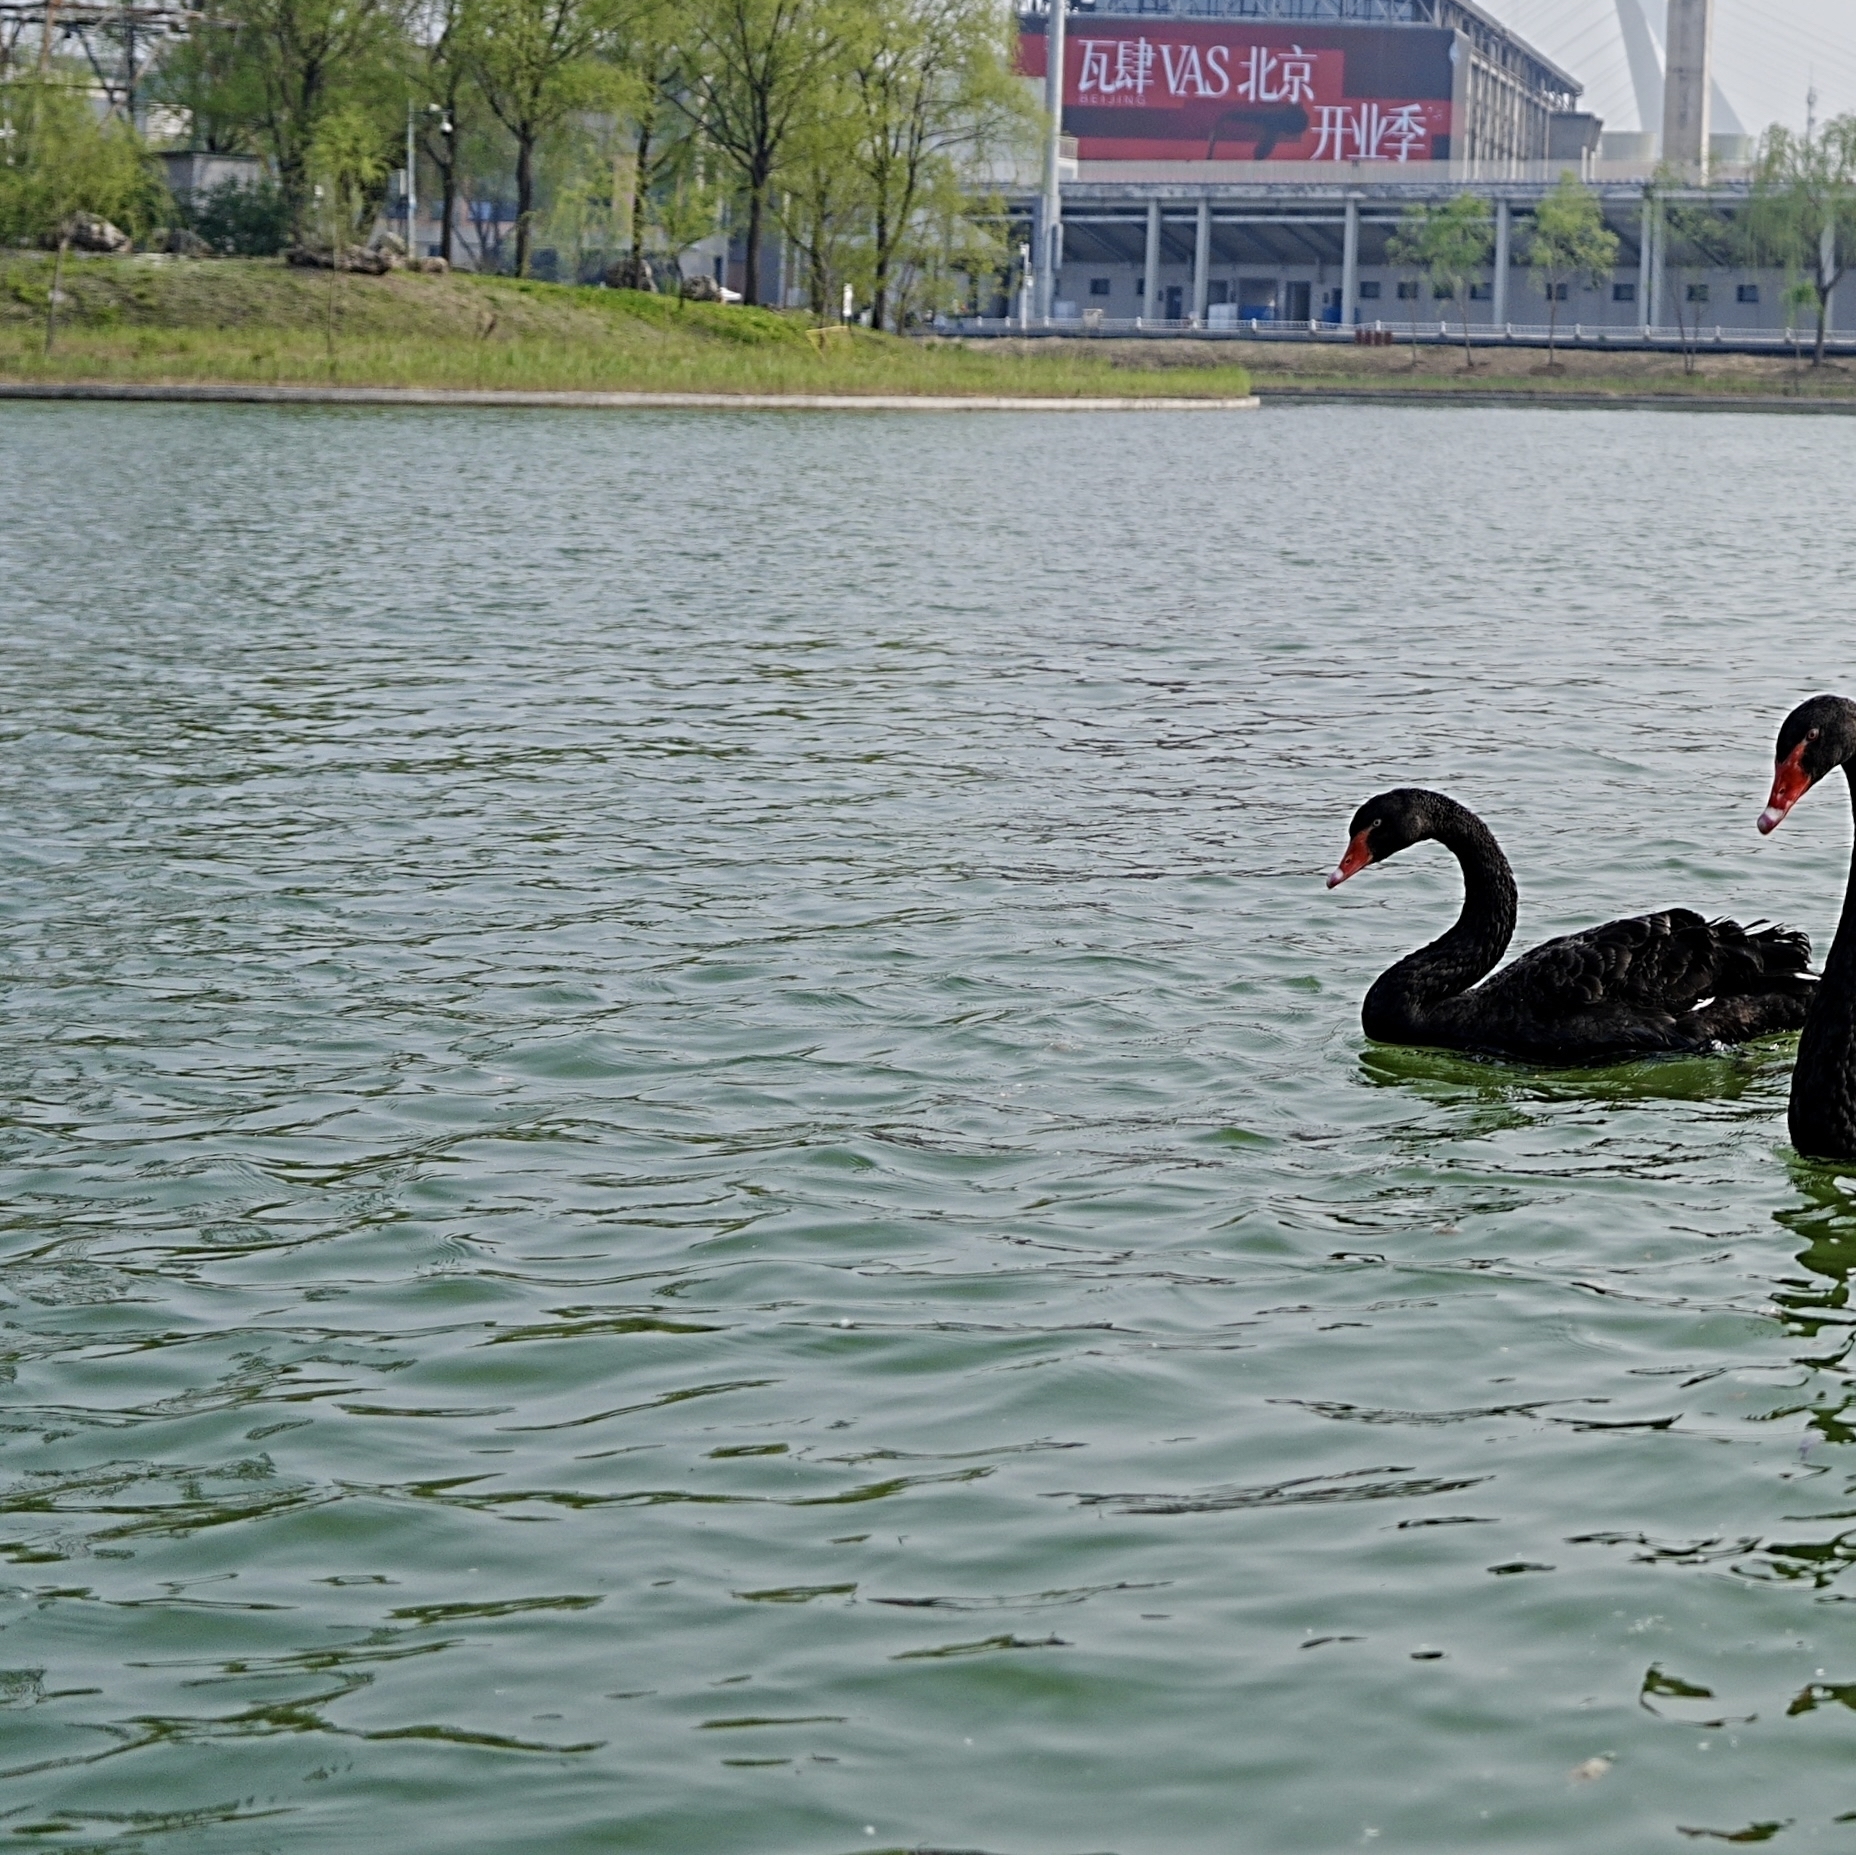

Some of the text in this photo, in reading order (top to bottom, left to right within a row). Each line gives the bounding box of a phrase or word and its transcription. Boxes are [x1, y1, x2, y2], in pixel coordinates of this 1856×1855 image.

[1077, 36, 1318, 103] 瓦肆 VAS 北京
[1079, 94, 1147, 107] BEIJING
[1310, 102, 1427, 162] 开业季
